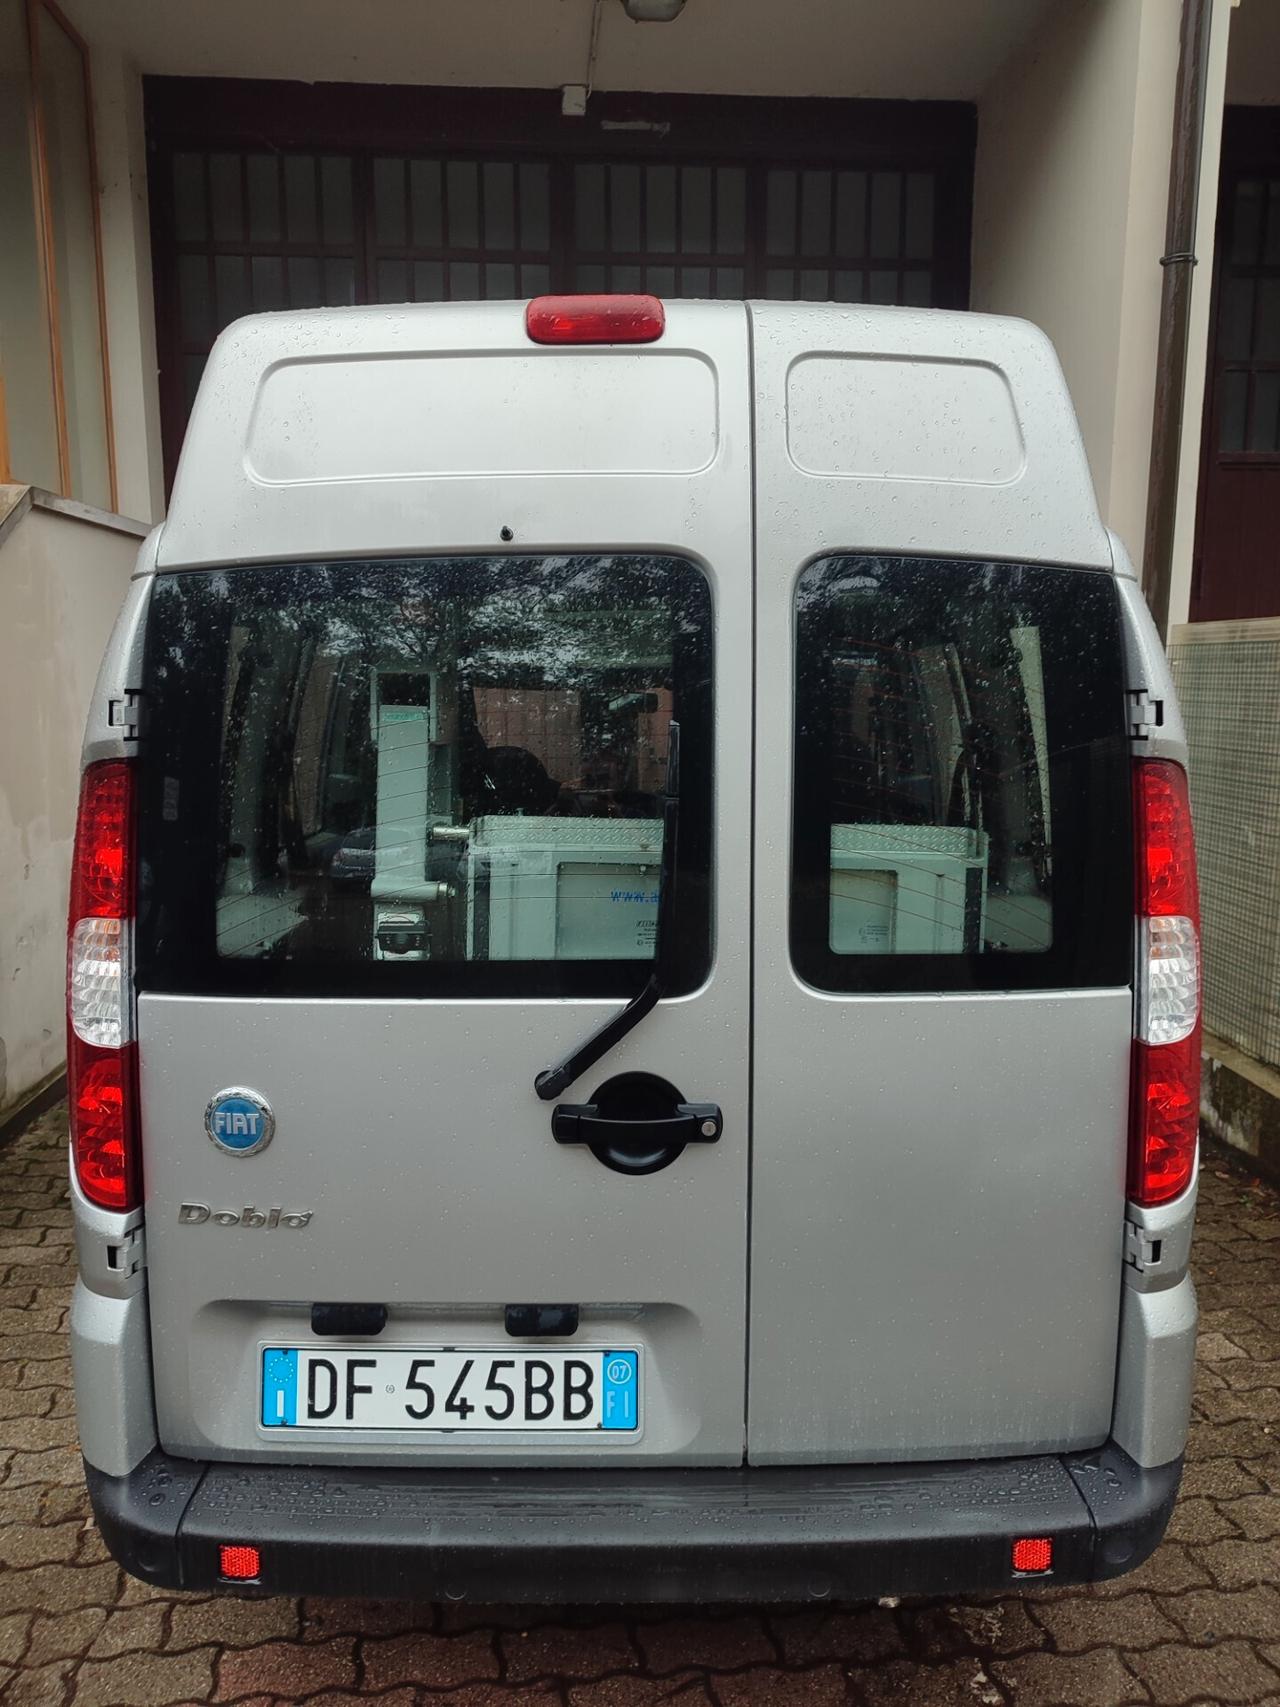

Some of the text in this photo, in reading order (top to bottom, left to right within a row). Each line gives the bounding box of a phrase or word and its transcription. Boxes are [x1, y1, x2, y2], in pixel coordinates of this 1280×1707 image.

[214, 1111, 259, 1135] FIAT
[611, 1364, 627, 1380] 07
[307, 1358, 594, 1421] DF 545BB
[276, 1390, 285, 1418] I
